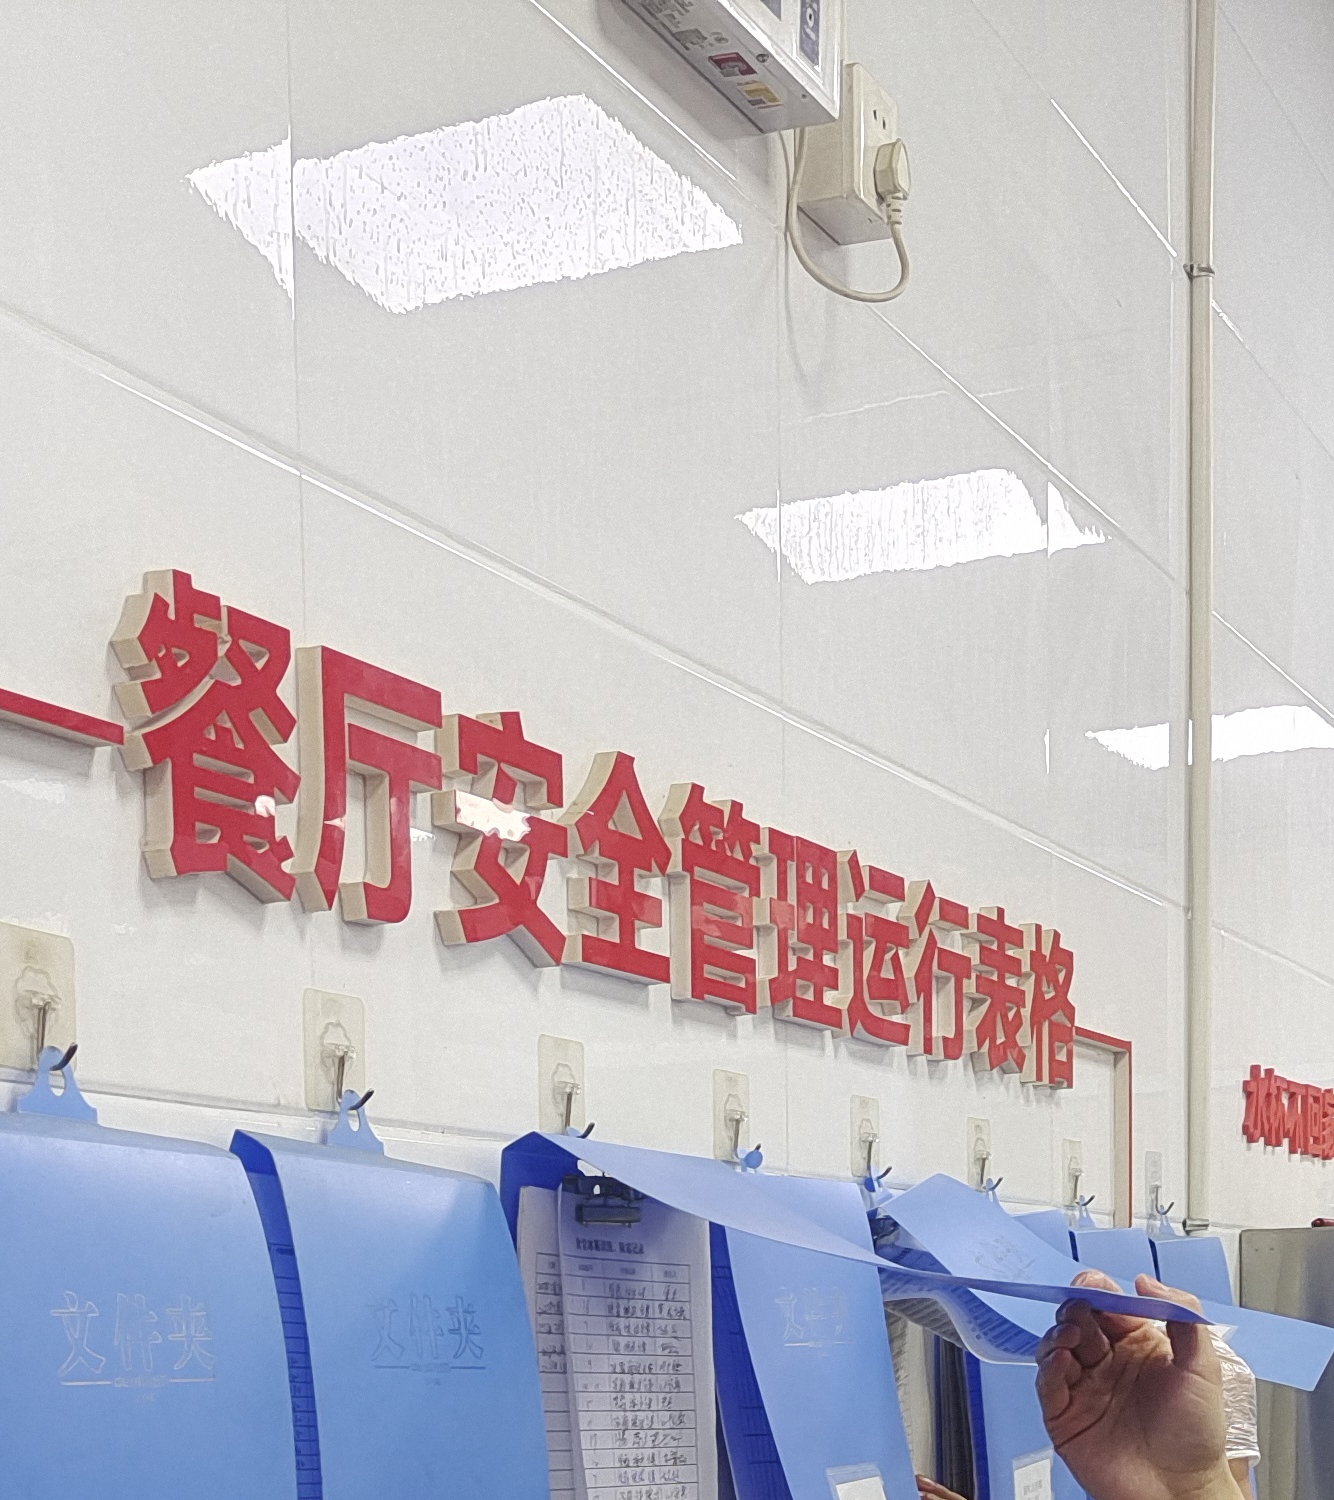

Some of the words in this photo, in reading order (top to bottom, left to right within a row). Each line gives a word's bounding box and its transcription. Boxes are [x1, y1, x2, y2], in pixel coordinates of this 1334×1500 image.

[110, 568, 1075, 1091] 餐厅安全管理运行表格
[50, 1290, 215, 1378] 文件夹
[366, 1291, 484, 1361] 文件夹
